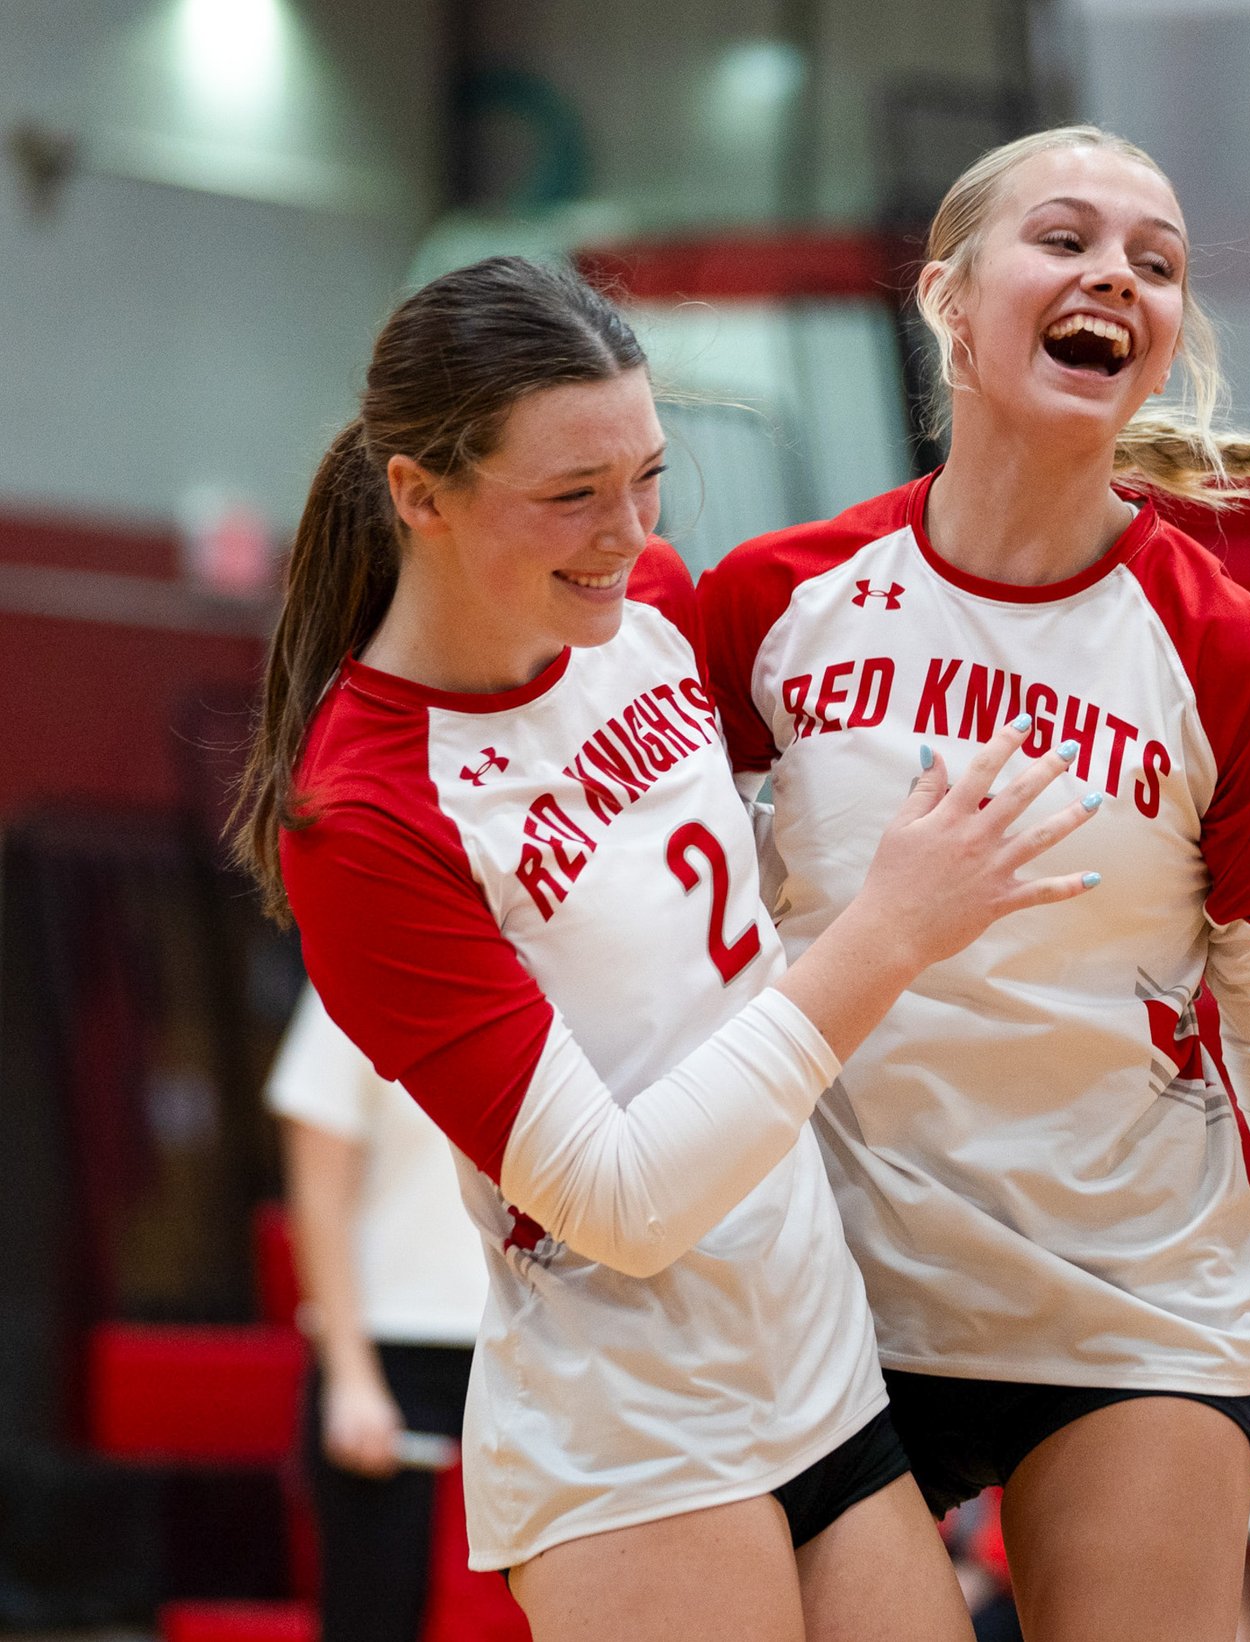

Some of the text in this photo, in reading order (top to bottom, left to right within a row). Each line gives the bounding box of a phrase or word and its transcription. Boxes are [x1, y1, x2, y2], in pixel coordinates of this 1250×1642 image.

[515, 677, 719, 923] RED KNIGHTS
[782, 656, 1171, 819] RED KNIGHTS
[664, 818, 762, 988] 2
